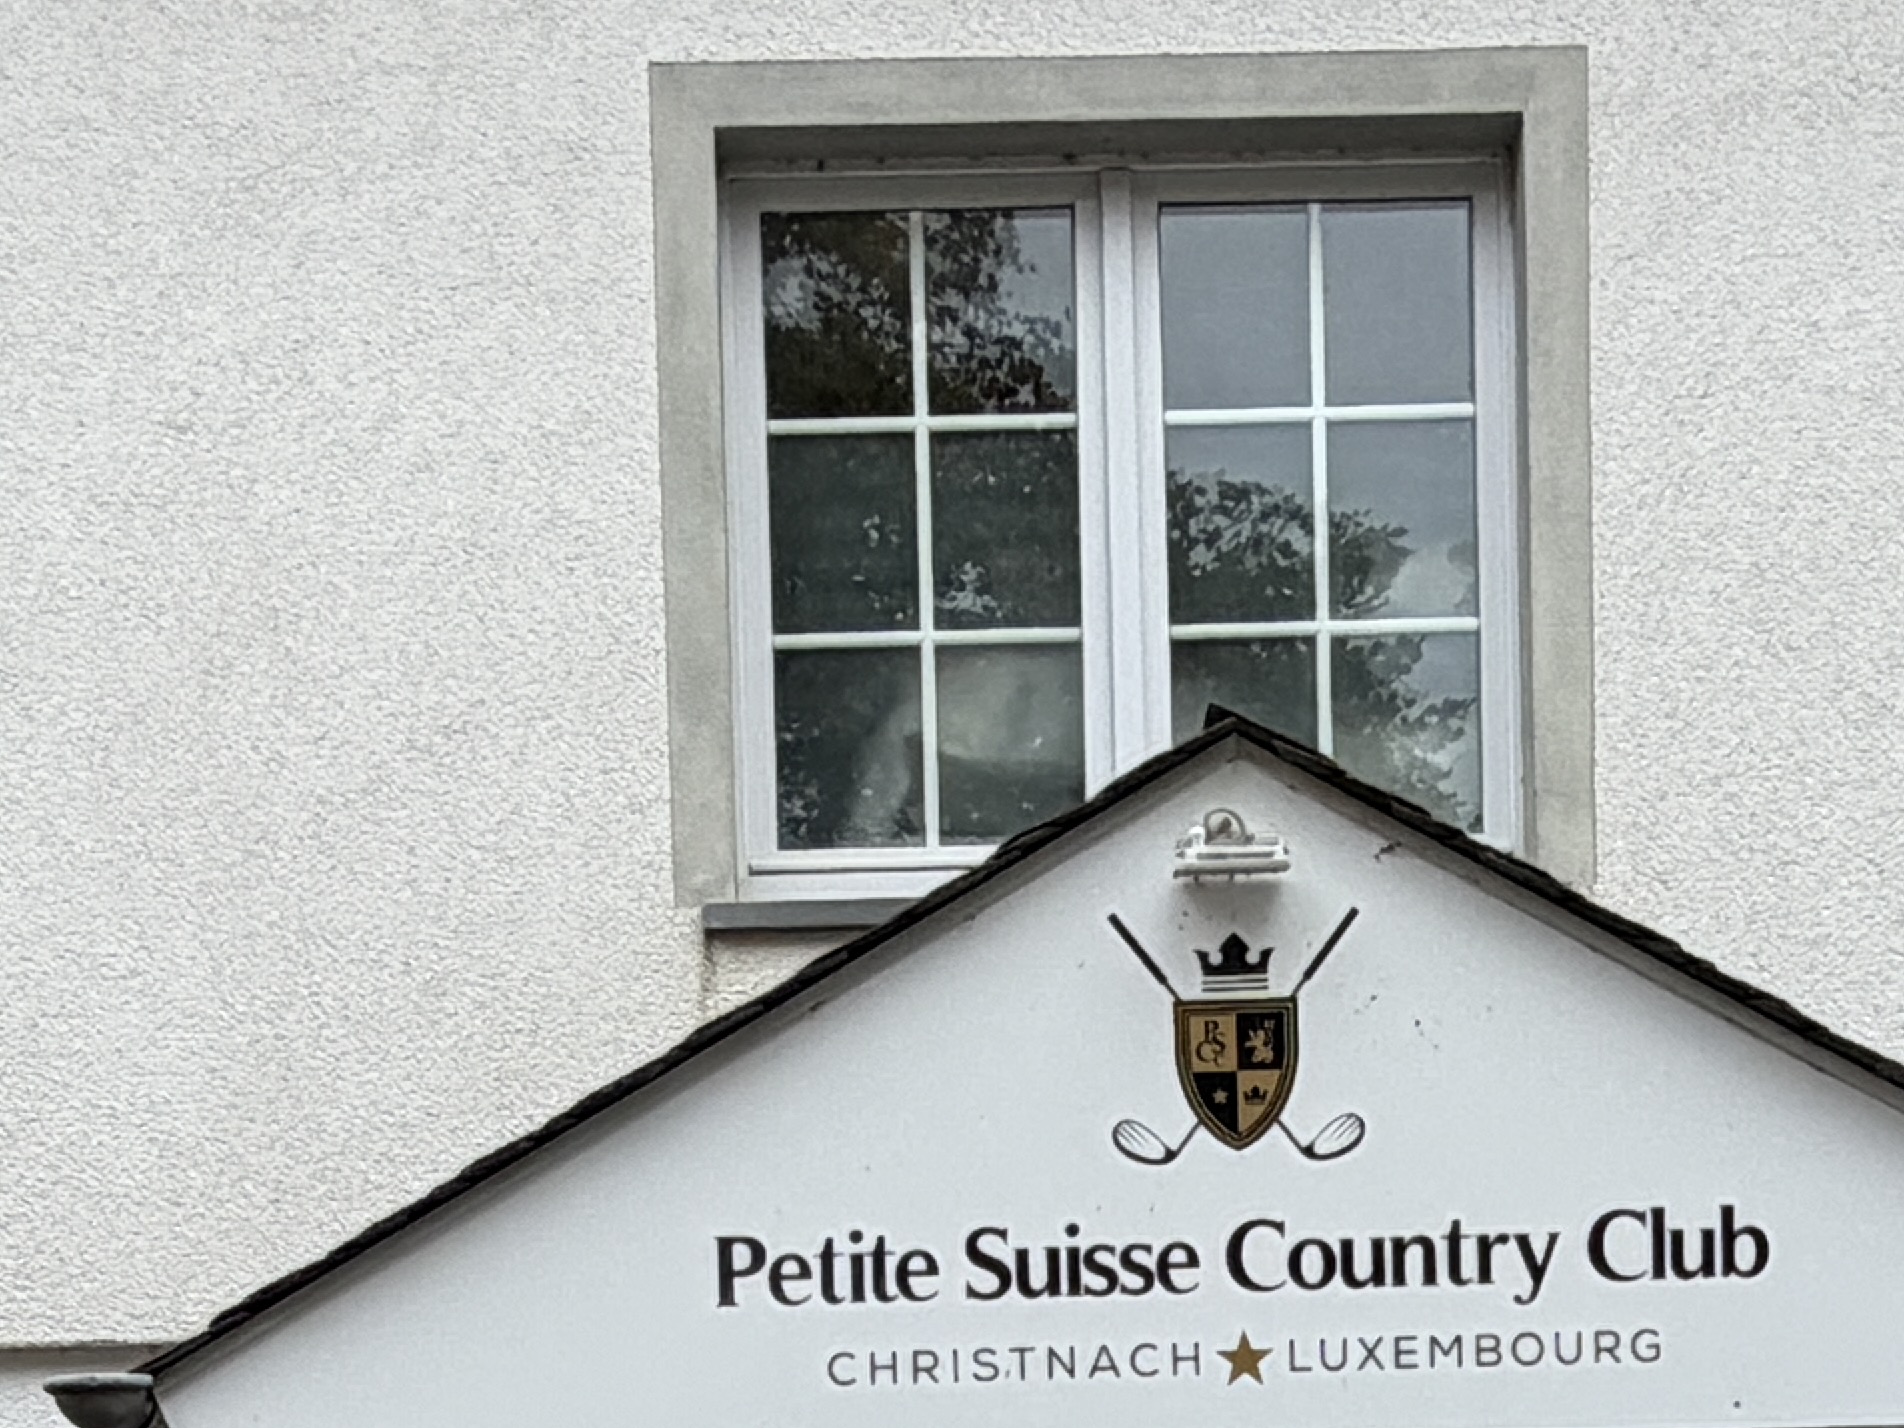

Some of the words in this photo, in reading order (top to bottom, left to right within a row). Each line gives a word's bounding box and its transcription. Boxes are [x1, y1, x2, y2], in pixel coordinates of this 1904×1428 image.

[716, 1230, 940, 1308] Petite
[964, 1222, 1200, 1300] Suisse
[1226, 1218, 1560, 1306] Country
[1586, 1204, 1770, 1282] Club
[827, 1340, 1203, 1387] CHRISTNACH
[1288, 1327, 1663, 1373] LUXEMBOURG
